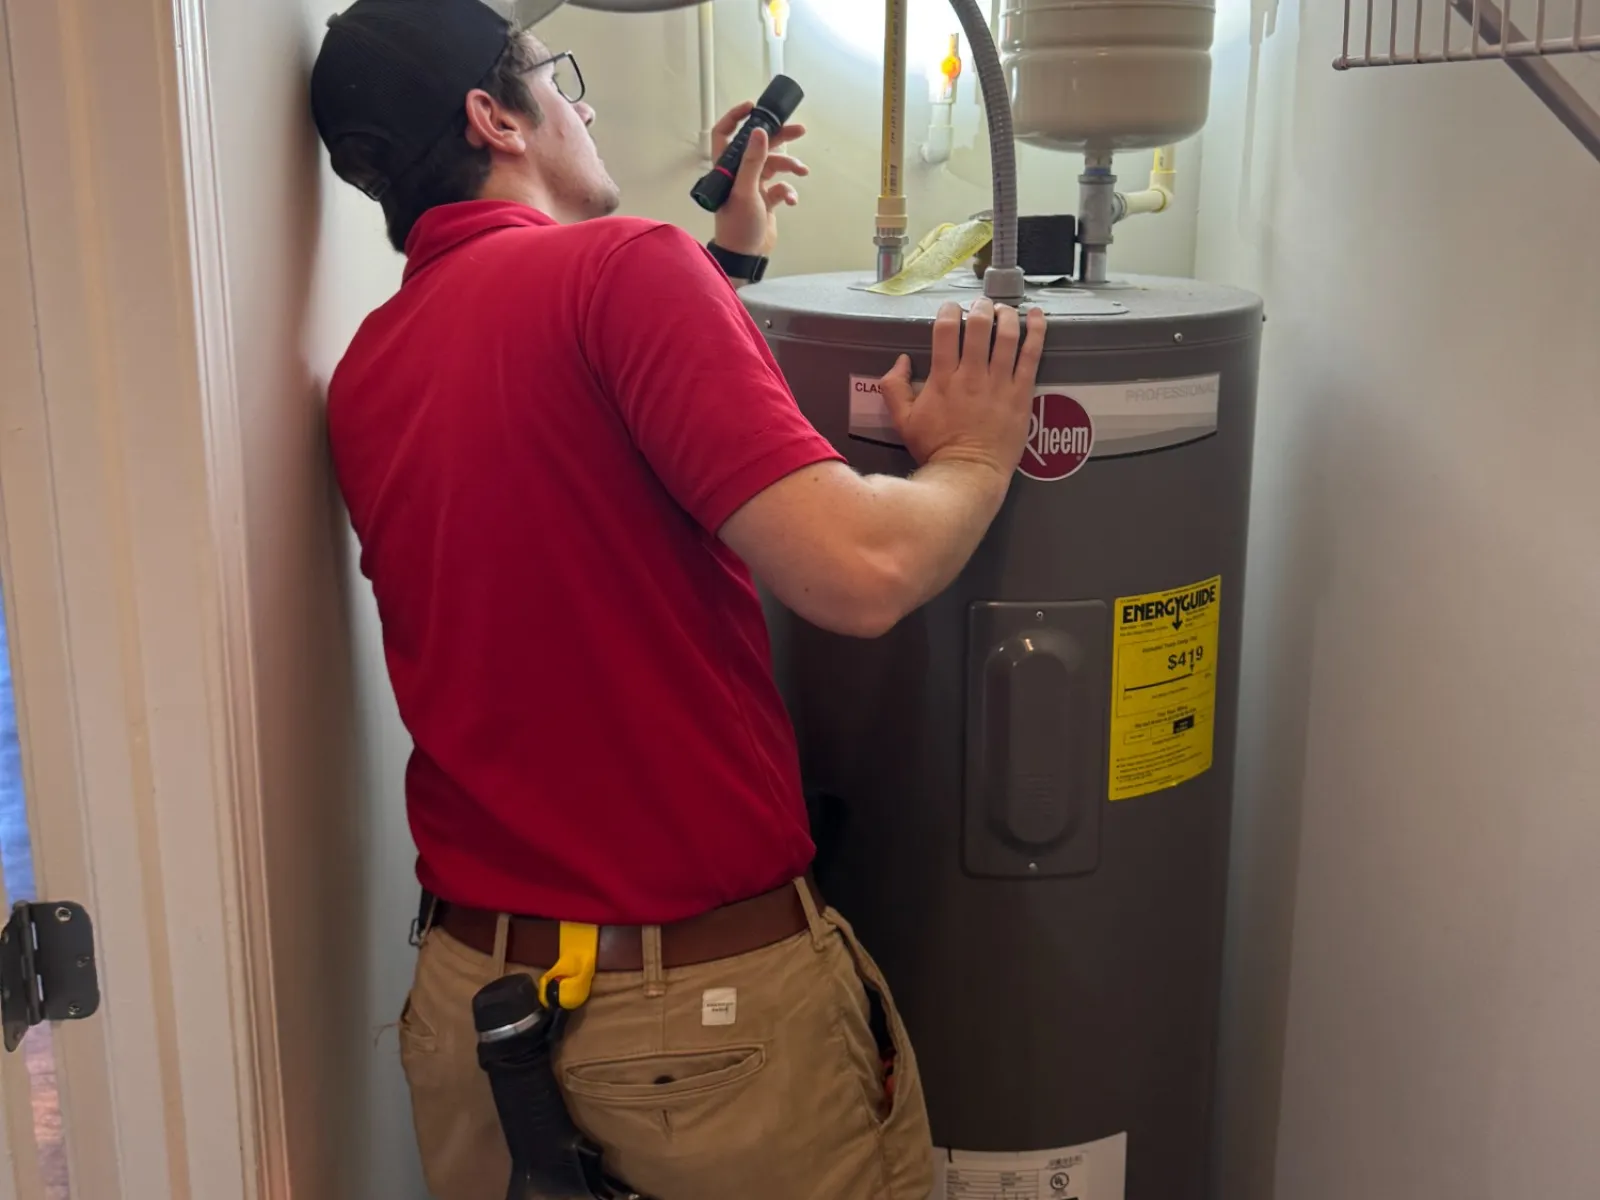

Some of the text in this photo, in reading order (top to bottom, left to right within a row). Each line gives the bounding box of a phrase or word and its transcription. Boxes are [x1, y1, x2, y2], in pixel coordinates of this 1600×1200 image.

[855, 382, 882, 394] CLAS
[1125, 381, 1217, 403] PROFESSIONAL
[1025, 395, 1089, 466] Rheem
[1167, 645, 1204, 671] $419
